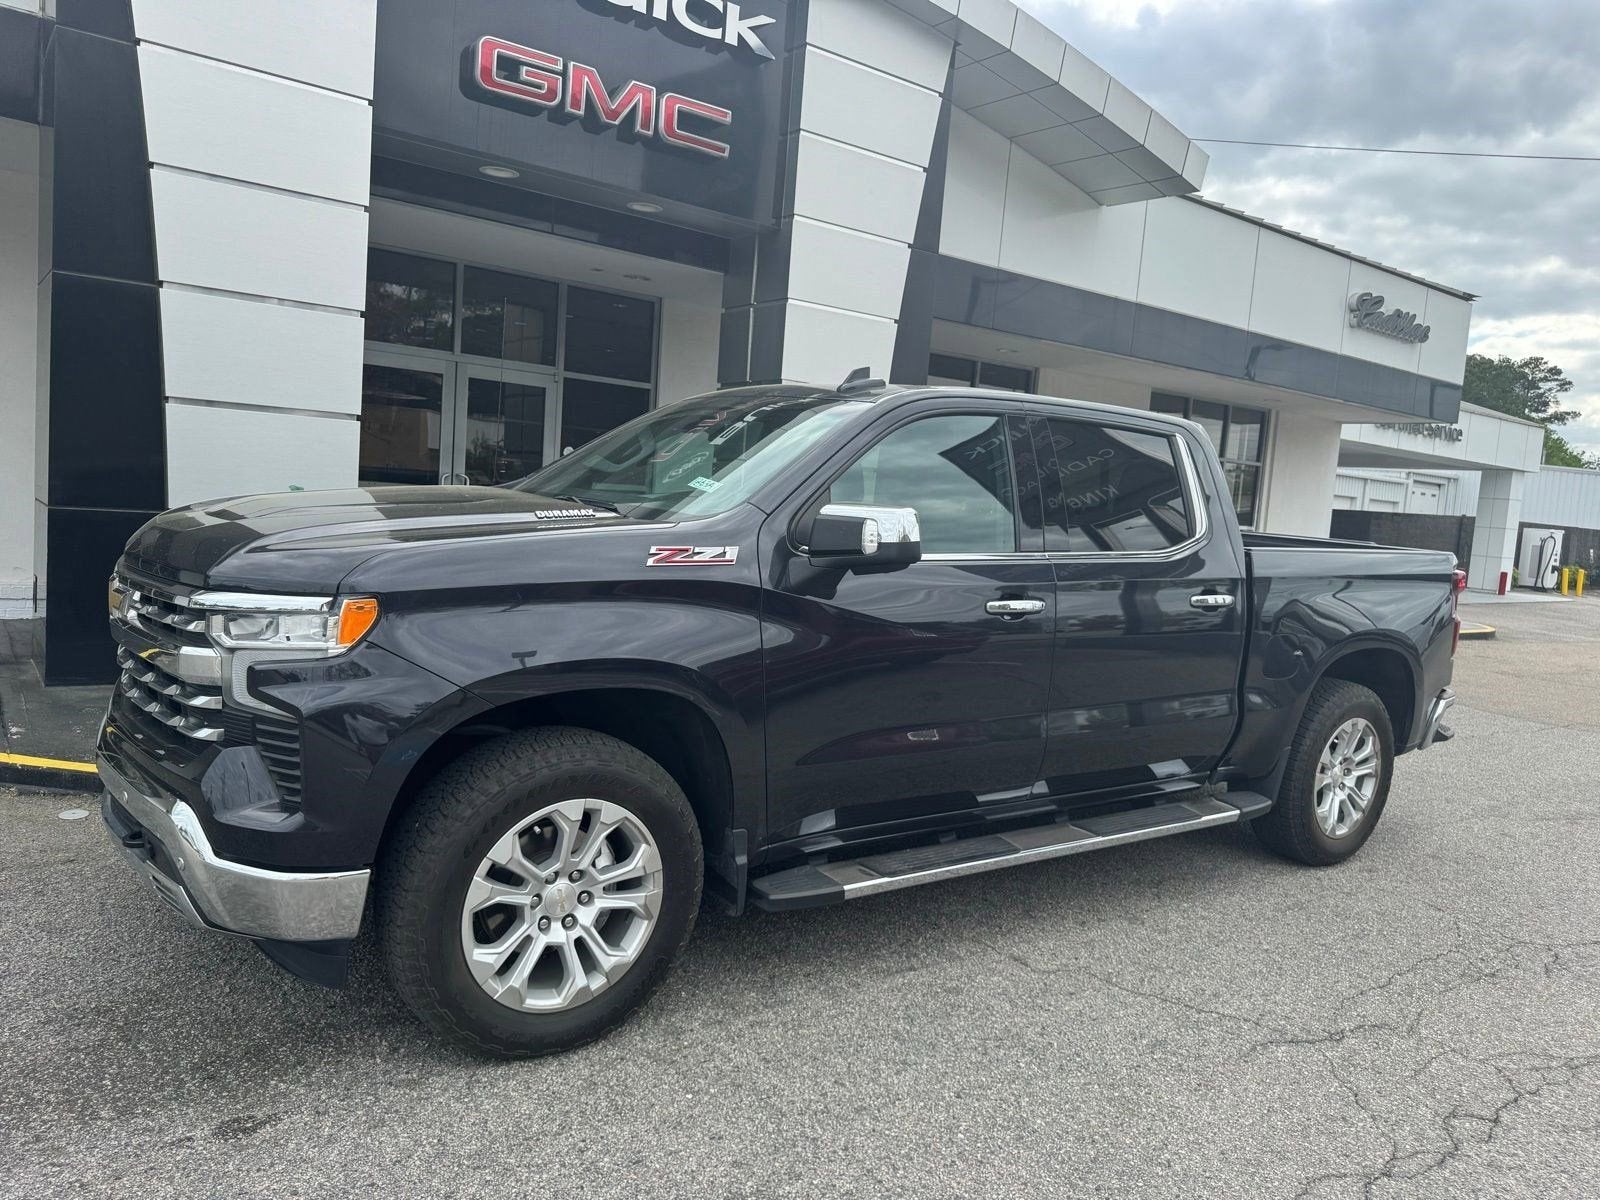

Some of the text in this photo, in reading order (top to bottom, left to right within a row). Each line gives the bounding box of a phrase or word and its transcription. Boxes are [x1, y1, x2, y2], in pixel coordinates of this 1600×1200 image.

[477, 36, 732, 159] GMC
[1351, 292, 1431, 344] Cadillac
[535, 509, 596, 519] DURAMAX
[646, 546, 740, 566] Z71
